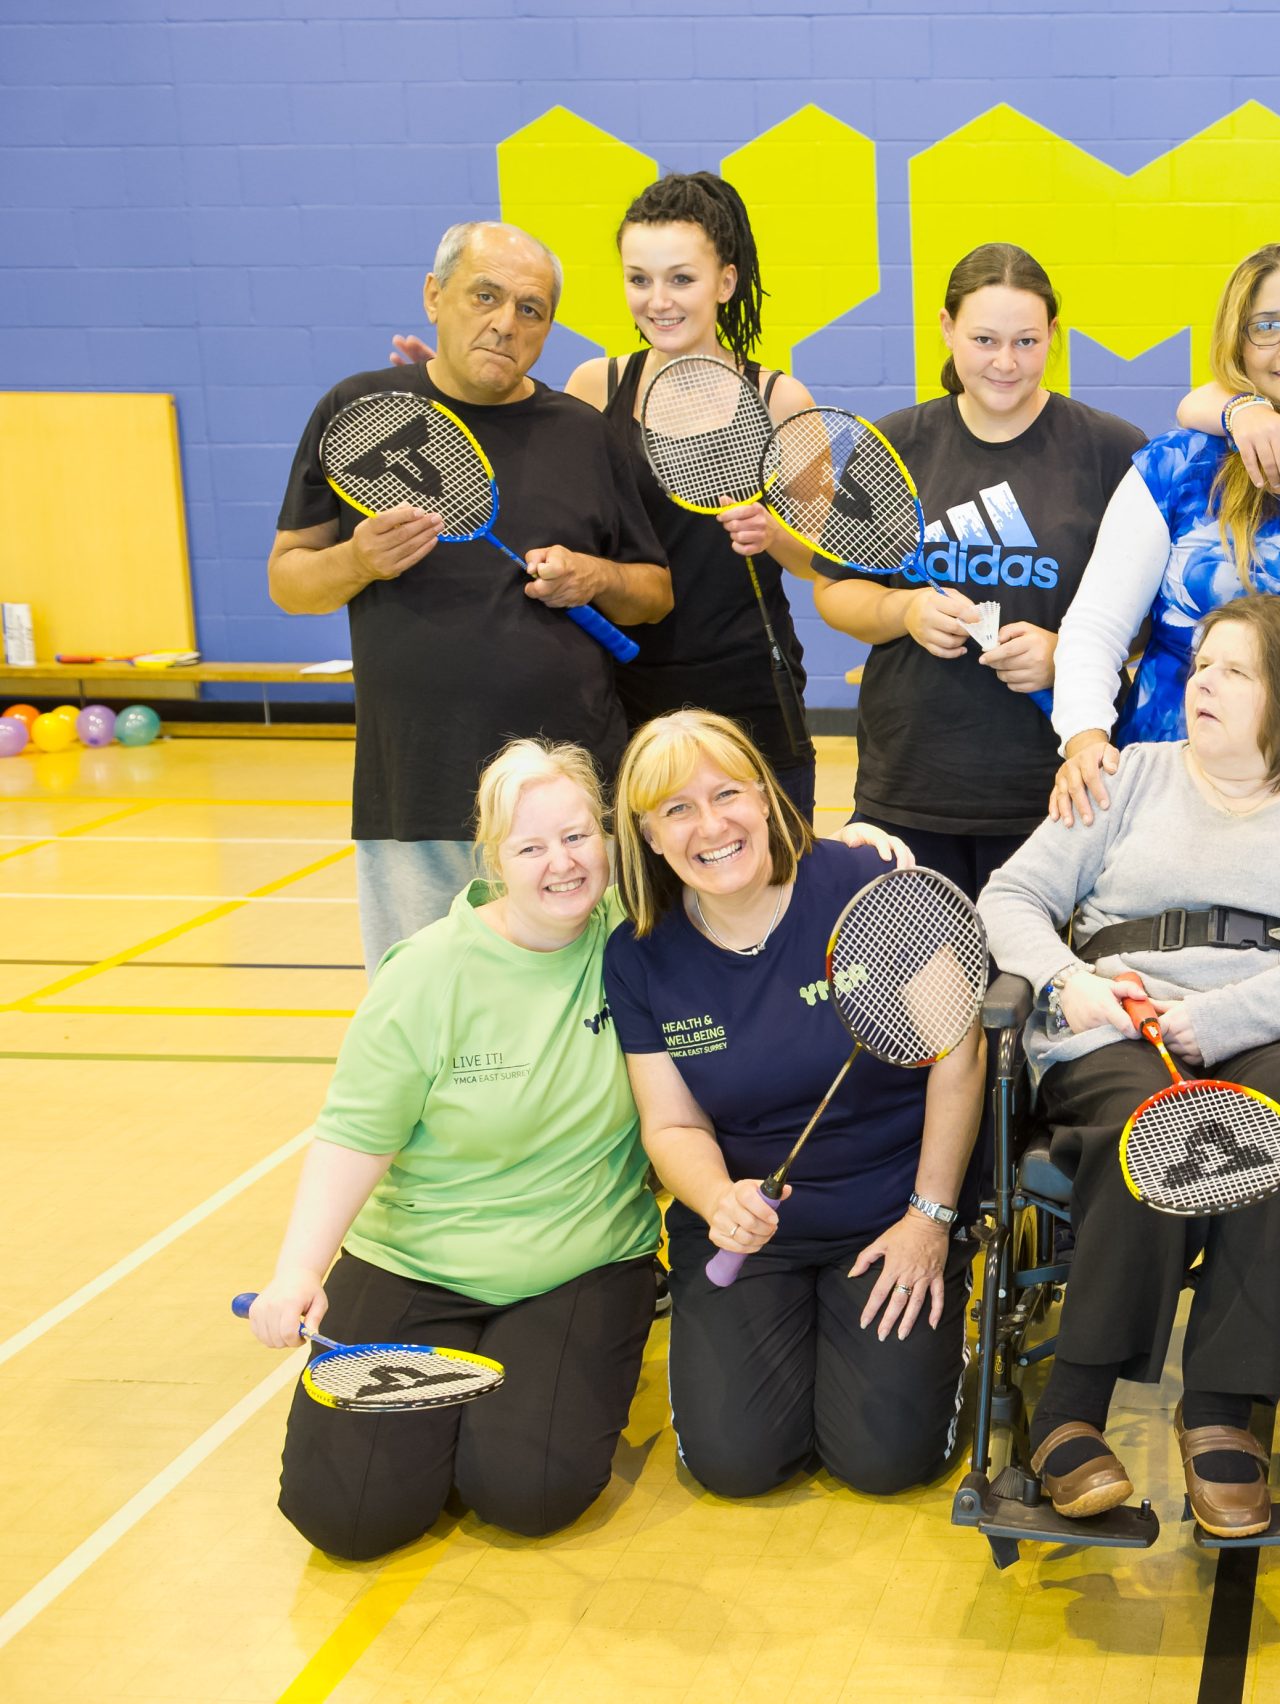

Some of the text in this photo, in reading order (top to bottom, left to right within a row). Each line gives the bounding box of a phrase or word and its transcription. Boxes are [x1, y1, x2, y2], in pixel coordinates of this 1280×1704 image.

[901, 540, 1059, 589] adidas
[662, 1014, 713, 1034] HEALTH &
[664, 1026, 726, 1047] WELLBEING
[669, 1041, 728, 1058] YMCA EAST SURREY
[453, 1052, 503, 1069] LIVE IT!
[453, 1069, 531, 1085] YMCA EAST SURREY
